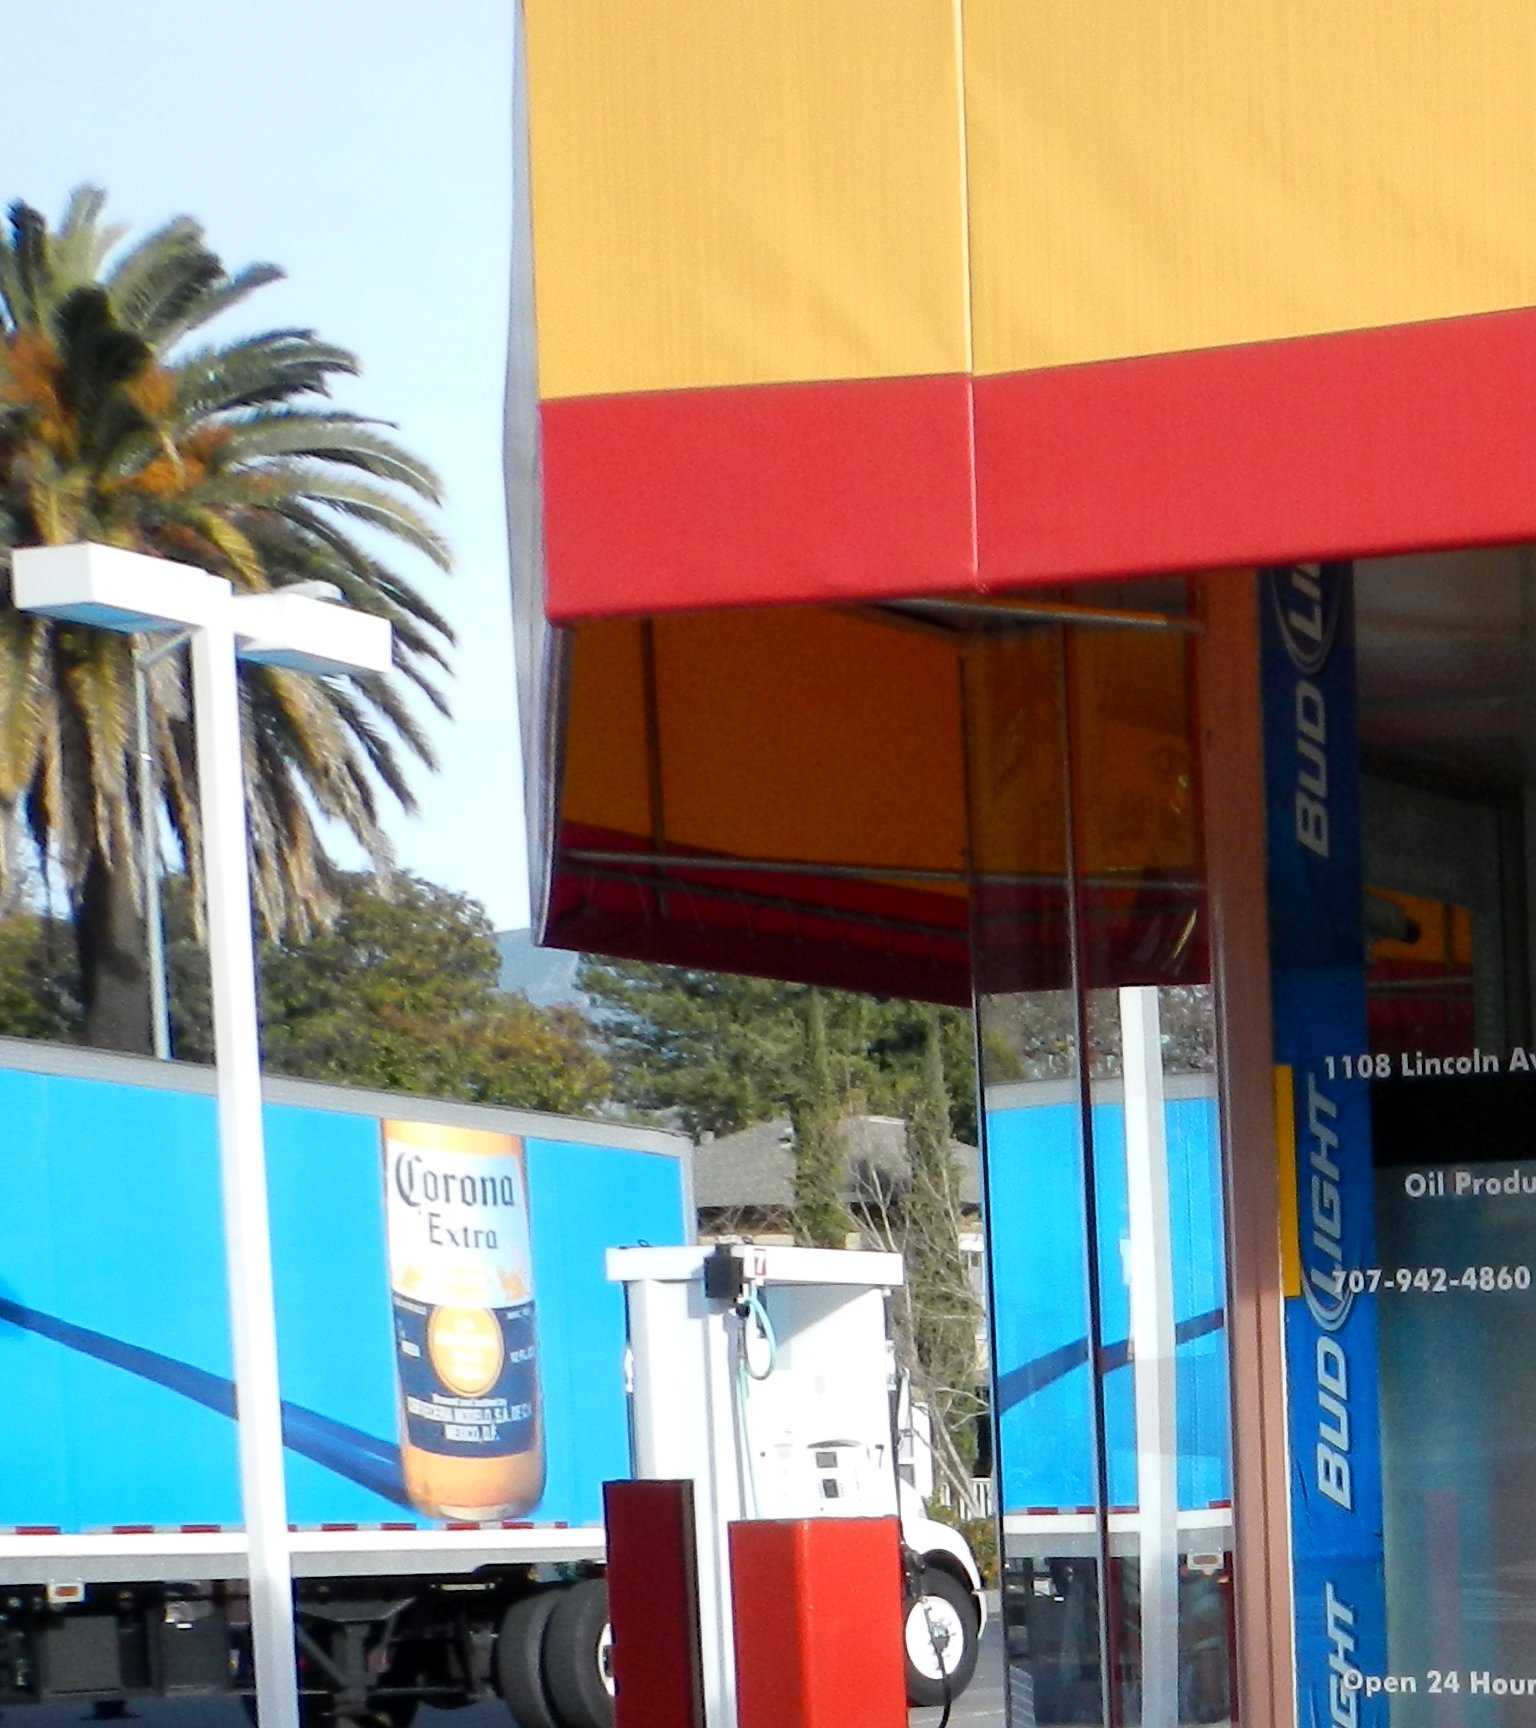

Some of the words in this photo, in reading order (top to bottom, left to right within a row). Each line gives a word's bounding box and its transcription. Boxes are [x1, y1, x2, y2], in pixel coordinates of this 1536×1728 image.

[1296, 679, 1329, 859] BUD
[1324, 1054, 1391, 1079] 1108
[1401, 1049, 1499, 1077] Lincoln
[396, 1152, 514, 1207] Corona
[1308, 1072, 1344, 1301] LIGHT
[1404, 1172, 1445, 1198] Oil
[428, 1212, 498, 1249] Extra
[1332, 1265, 1532, 1294] 707-942-4860
[1316, 1335, 1352, 1511] BUD
[1343, 1669, 1417, 1697] Open
[1426, 1670, 1460, 1694] 24
